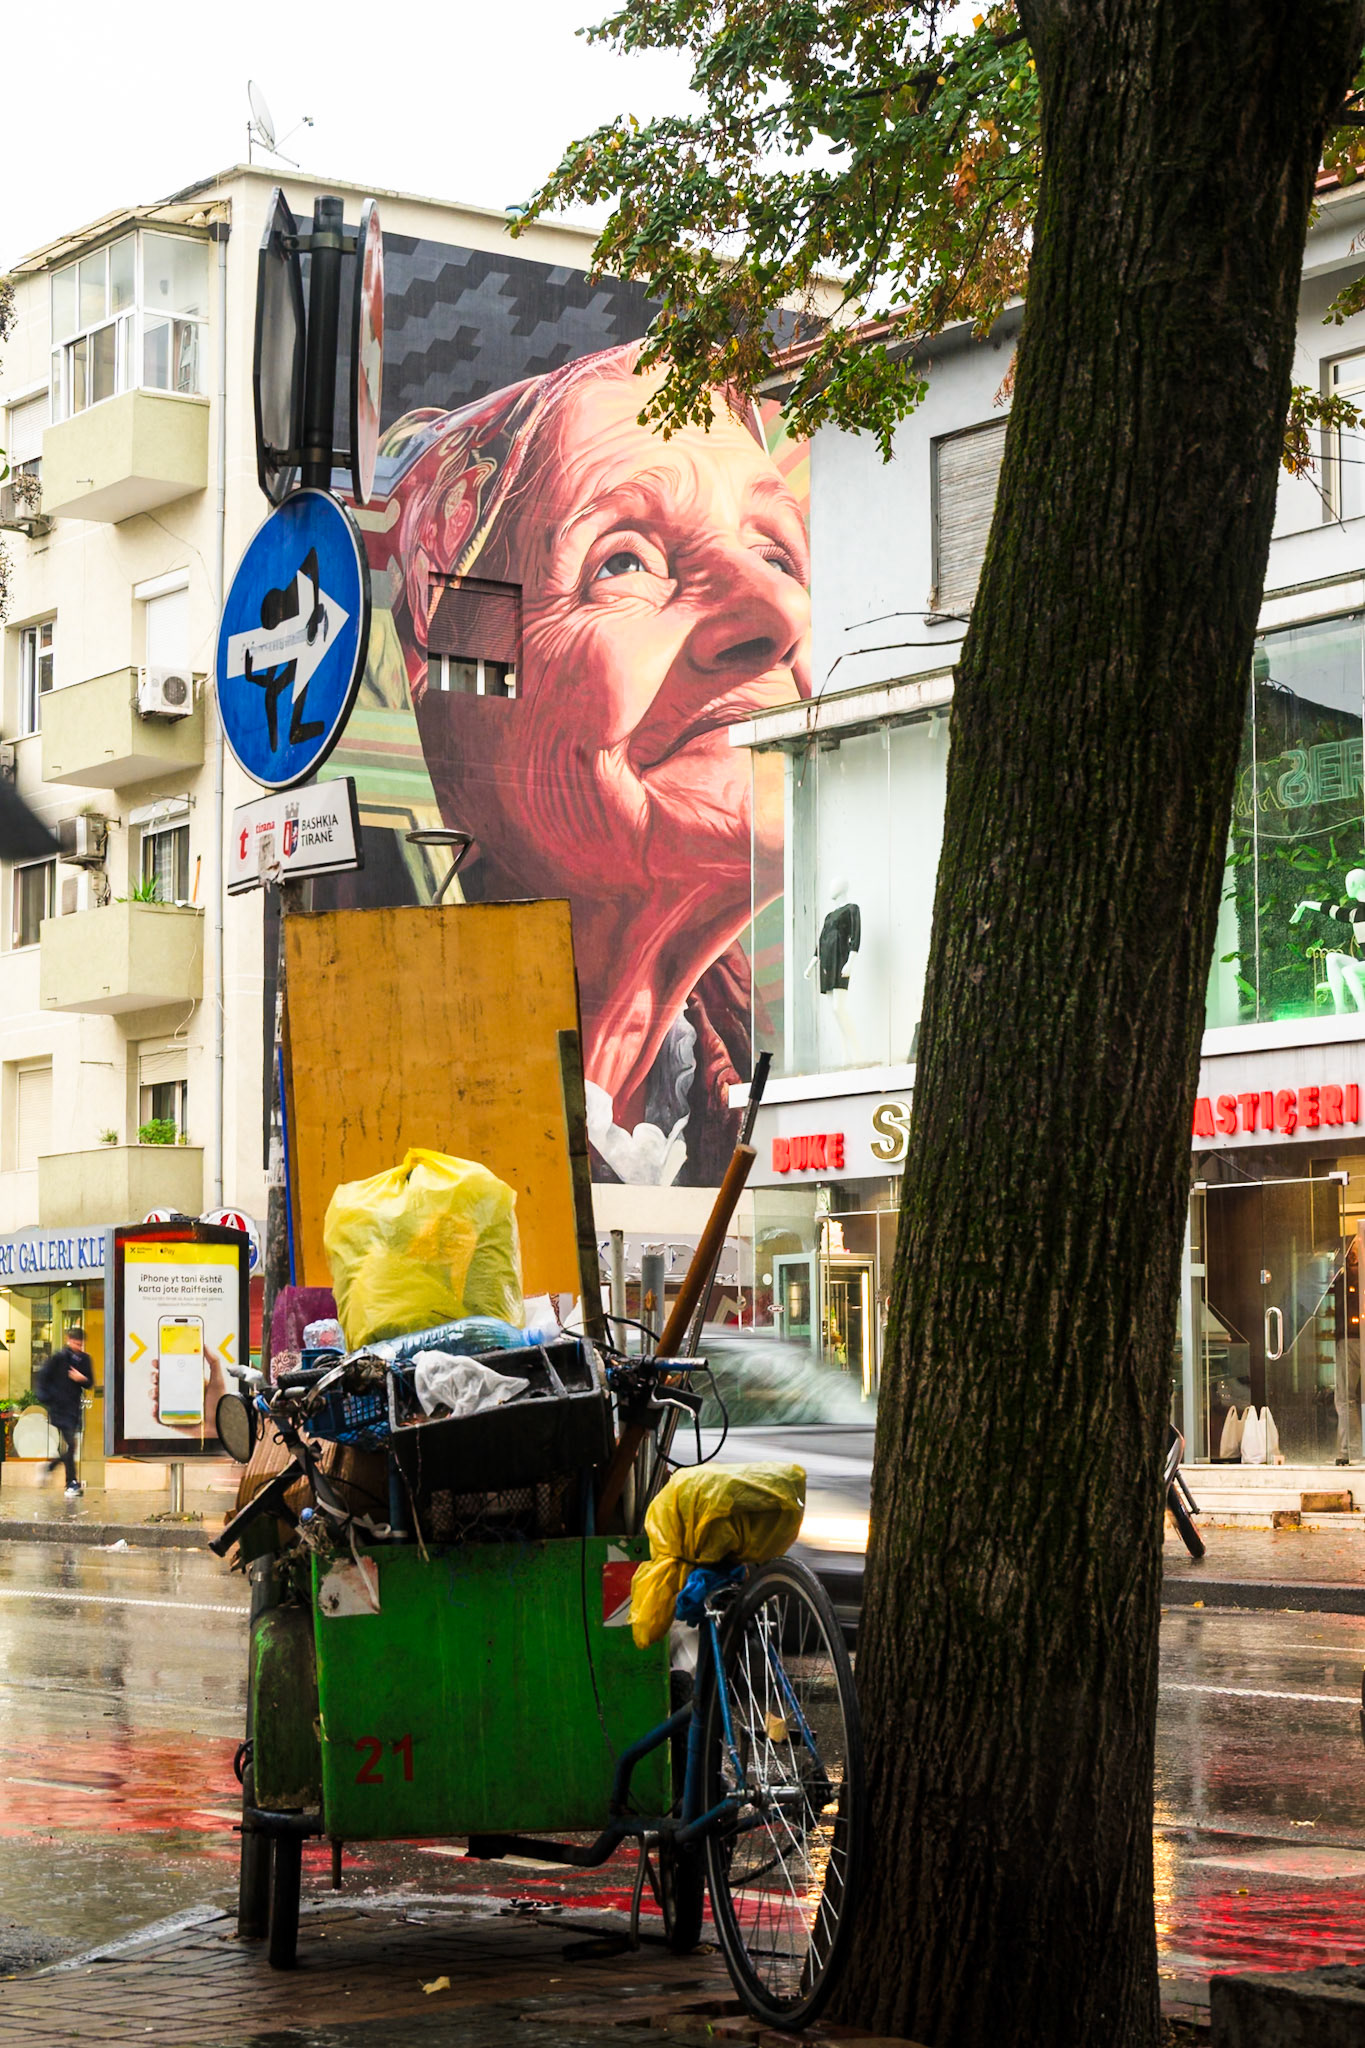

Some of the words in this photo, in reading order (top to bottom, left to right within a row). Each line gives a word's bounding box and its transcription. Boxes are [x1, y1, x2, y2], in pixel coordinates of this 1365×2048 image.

[256, 821, 275, 833] tirana
[302, 814, 339, 831] BASHKIA
[301, 827, 334, 846] TIRANË
[772, 1132, 845, 1172] BUKE
[19, 1239, 73, 1273] GALERI
[140, 1274, 169, 1283] iPhone
[171, 1276, 179, 1284] yt
[181, 1275, 198, 1283] tani
[199, 1274, 223, 1283] është
[138, 1285, 161, 1293] karta
[163, 1285, 179, 1294] jote
[181, 1285, 225, 1293] Raiffeisen.
[355, 1733, 414, 1784] 21
